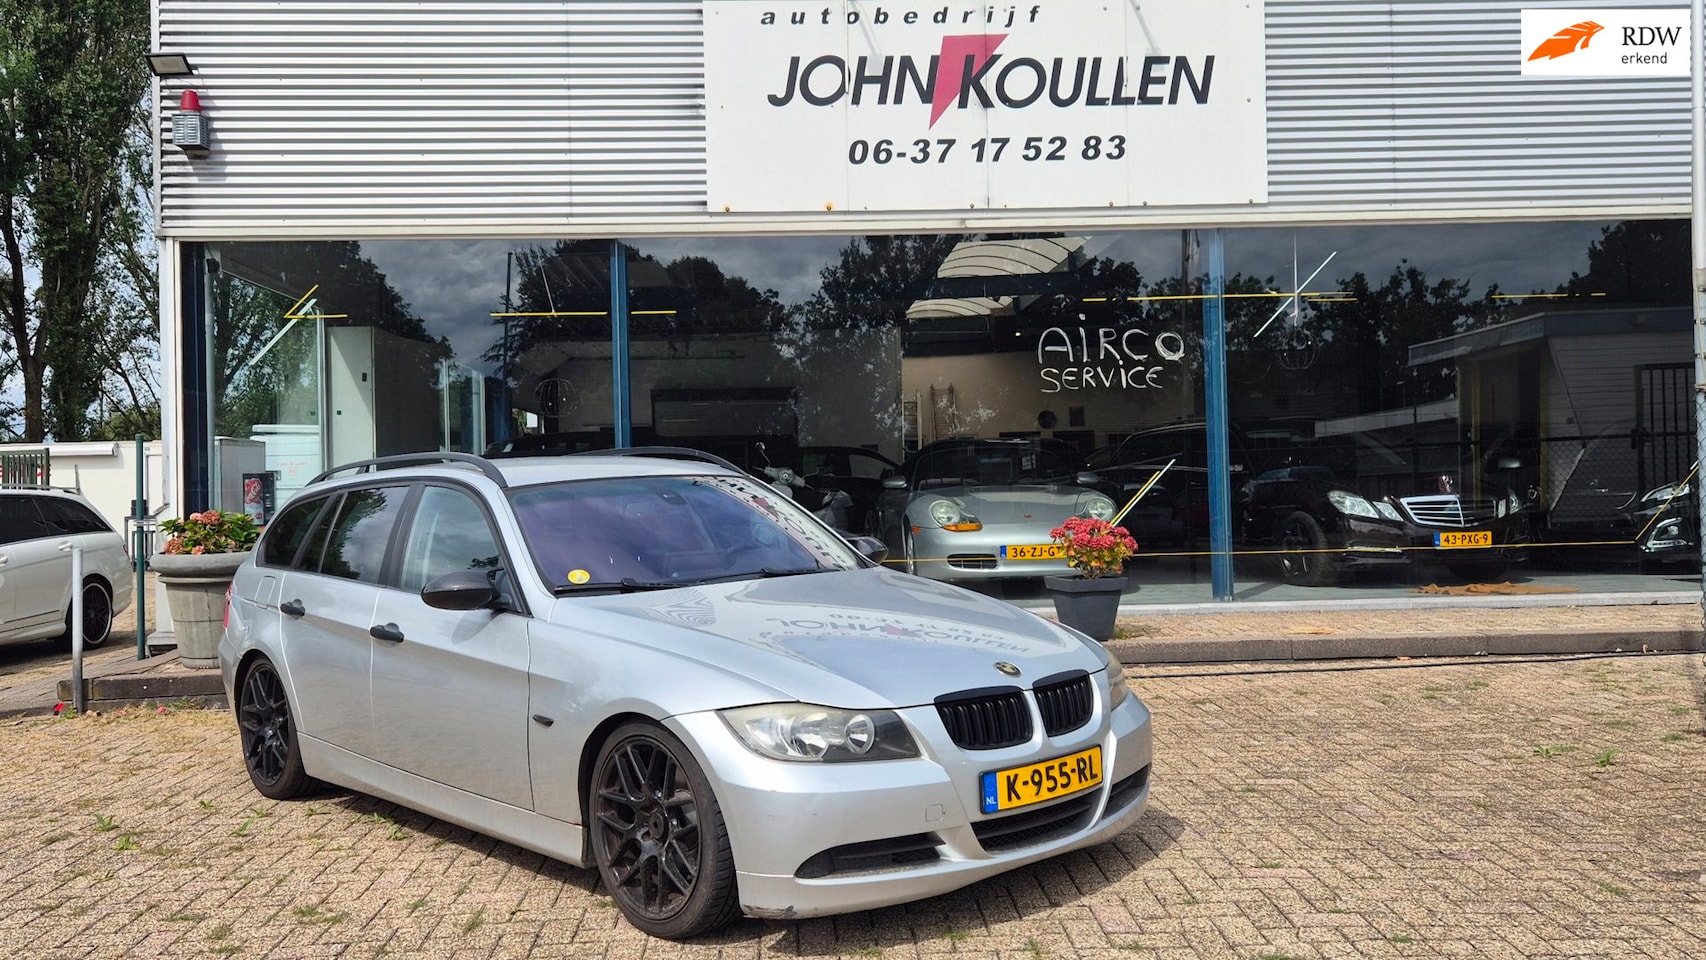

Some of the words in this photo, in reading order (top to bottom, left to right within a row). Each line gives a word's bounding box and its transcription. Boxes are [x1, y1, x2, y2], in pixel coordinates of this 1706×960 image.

[760, 6, 1040, 28] autobedrijf
[767, 54, 941, 107] JOHN
[957, 54, 1216, 109] KOULLEN
[848, 138, 957, 165] 06-37
[970, 137, 1011, 163] 17
[1021, 136, 1068, 162] 52
[1080, 135, 1127, 161] 83
[1443, 533, 1489, 545] 43-PXG-9
[1006, 754, 1098, 802] K-955-RL
